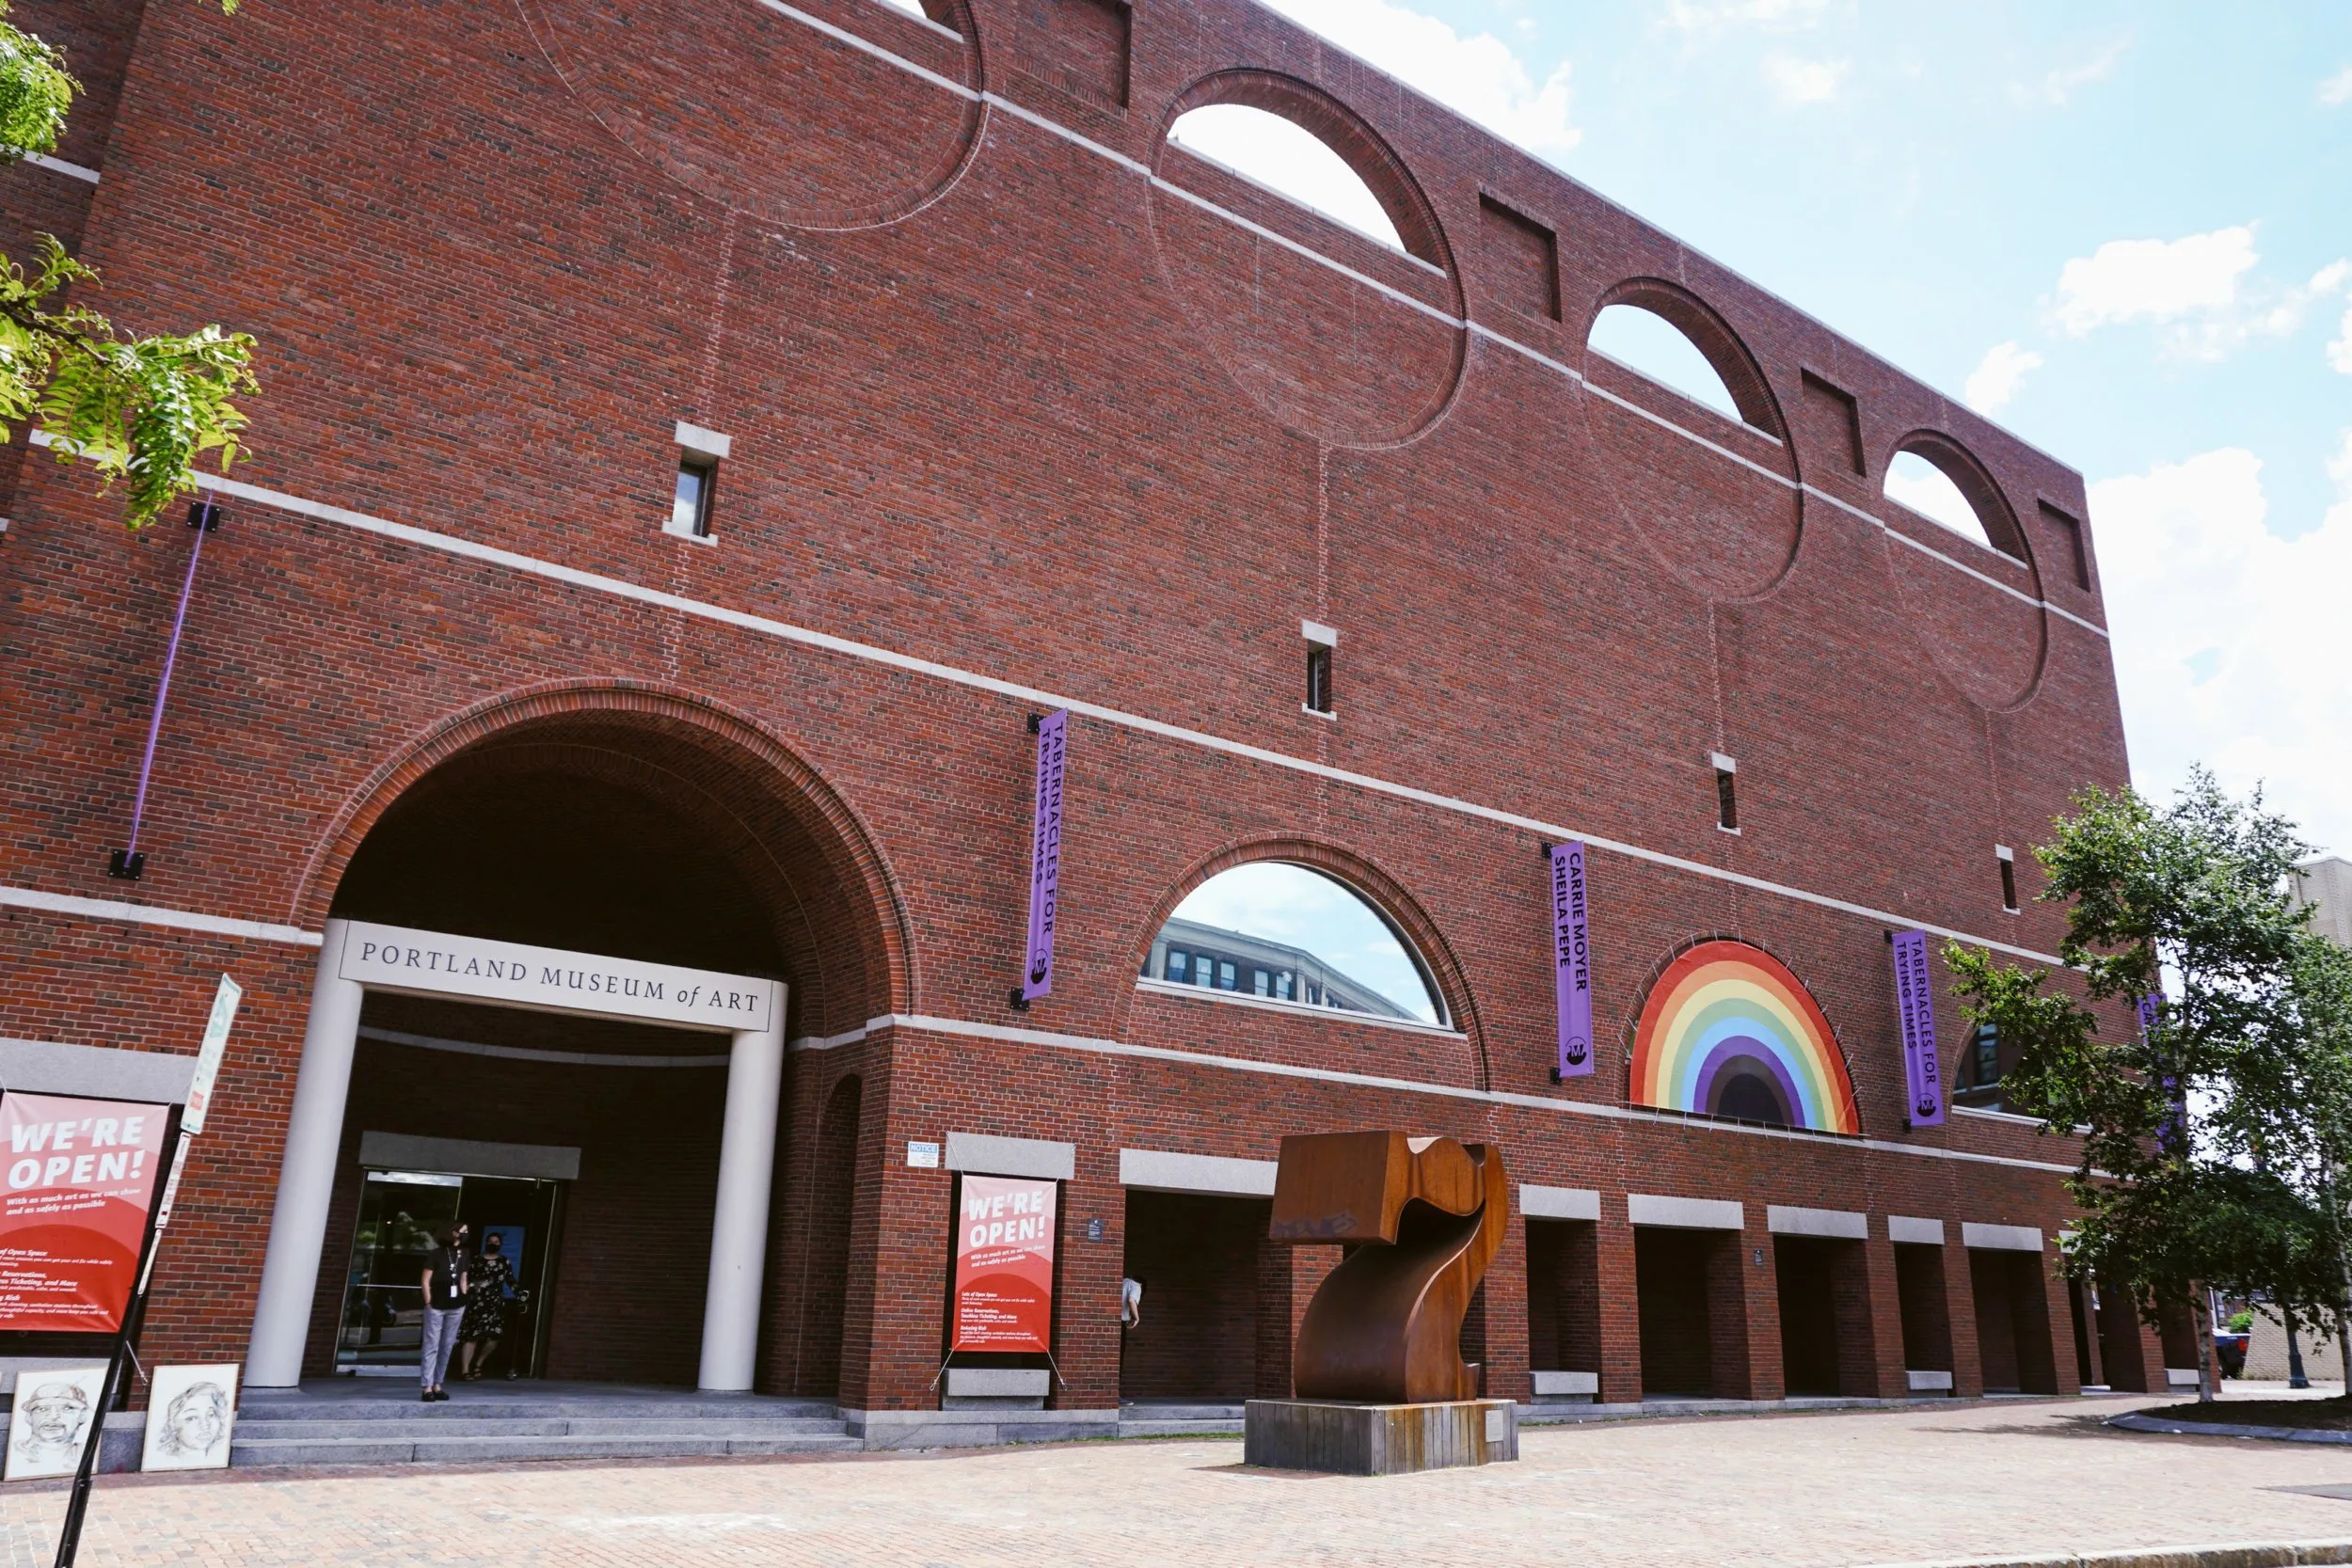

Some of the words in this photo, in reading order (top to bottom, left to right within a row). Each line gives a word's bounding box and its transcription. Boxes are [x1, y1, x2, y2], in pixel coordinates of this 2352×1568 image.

[1040, 727, 1050, 810] TRYING
[1047, 721, 1063, 879] TABERNACLES
[1036, 817, 1046, 884] TIMES
[1555, 856, 1567, 921] SHEILA
[1570, 852, 1583, 920] CARRIE
[1043, 889, 1055, 934] FOR
[1559, 924, 1570, 968] PEPE
[1574, 925, 1587, 991] MOYER
[361, 942, 527, 981] PORTLAND
[541, 967, 664, 1000] MUSEUM
[677, 986, 701, 1006] of
[708, 990, 758, 1012] ART
[1898, 942, 1911, 998] TRYING
[1904, 1004, 1916, 1050] TIMES
[1912, 939, 1932, 1047] TABERNACLES
[1924, 1053, 1935, 1084] FOR
[12, 1116, 145, 1153] WE'RE
[911, 1143, 936, 1152] NOTICE
[8, 1149, 145, 1189] OPEN!
[7, 1207, 24, 1215] and
[36, 1203, 60, 1213] safely
[73, 1199, 105, 1211] possible
[8, 1196, 27, 1205] With
[41, 1194, 63, 1202] much
[65, 1193, 77, 1201] art
[968, 1191, 1042, 1221] WE'RE
[970, 1214, 1045, 1248] OPEN!
[10, 1278, 42, 1287] Ticketing,
